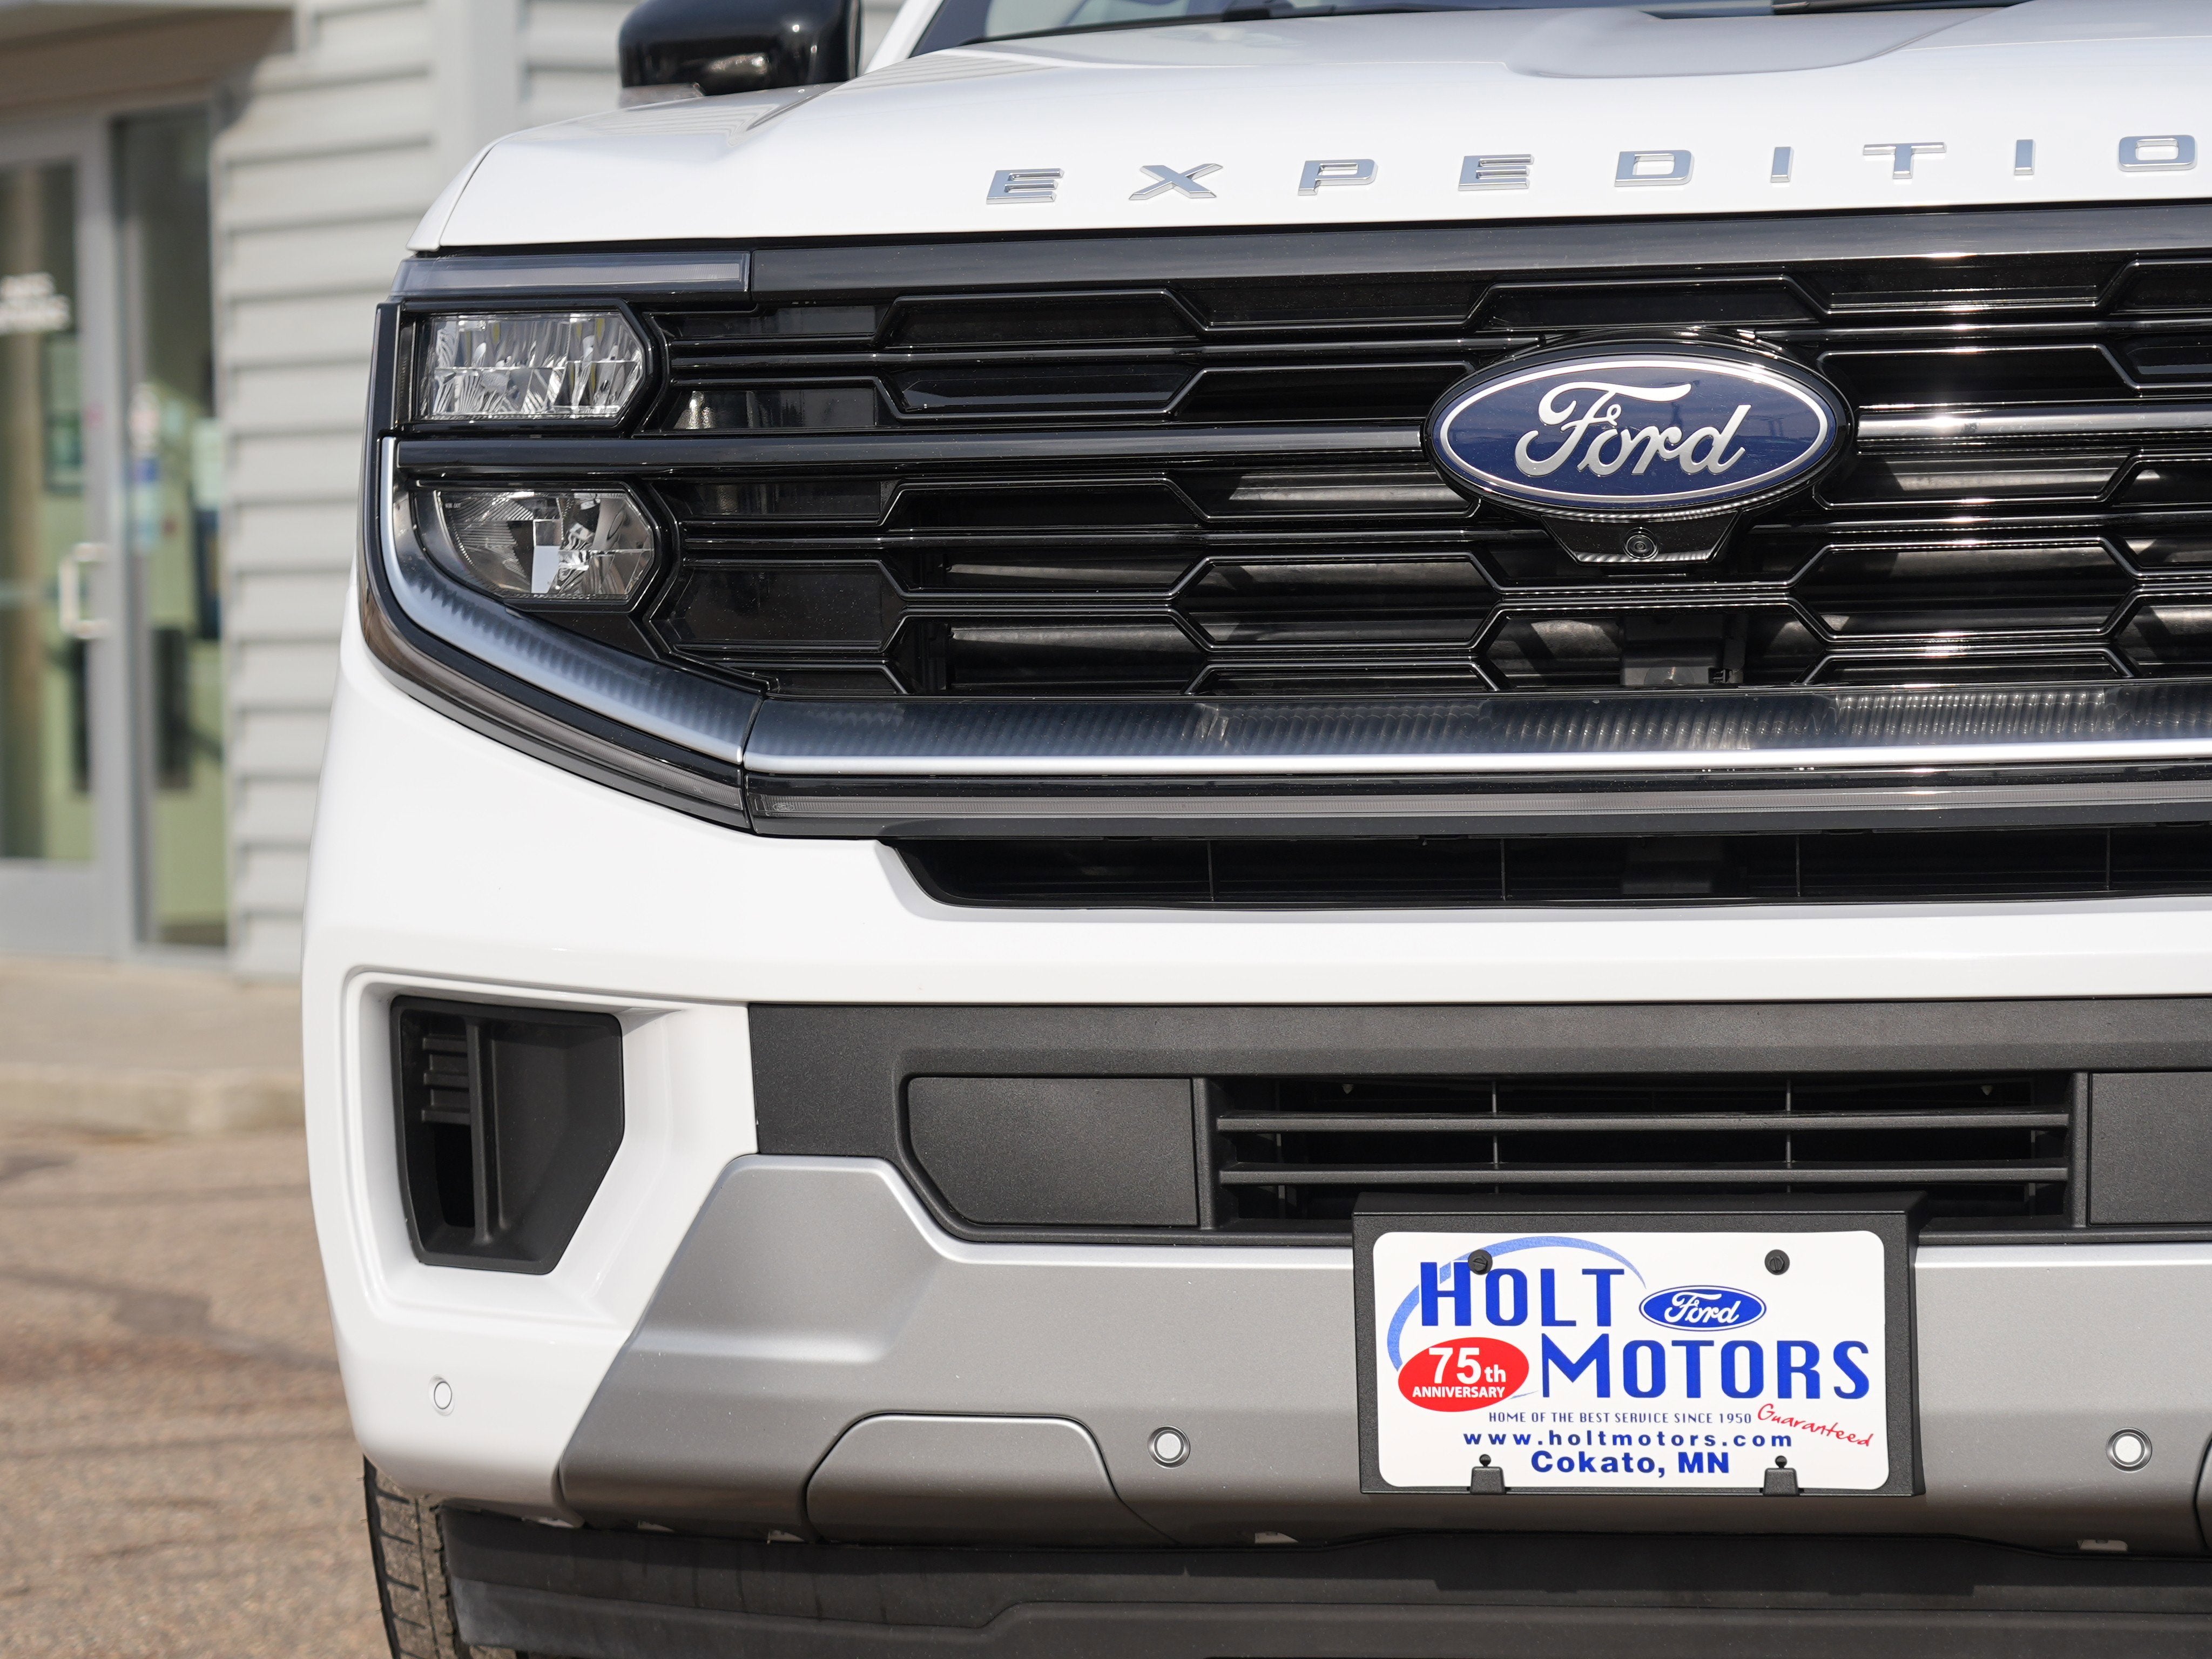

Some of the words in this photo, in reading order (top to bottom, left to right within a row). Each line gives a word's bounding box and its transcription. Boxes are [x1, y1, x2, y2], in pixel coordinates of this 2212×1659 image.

[986, 134, 2197, 204] EXPEDITIO
[1514, 381, 1752, 476] Ford
[1420, 1262, 1624, 1326] HOLT
[1664, 1291, 1742, 1323] Ford
[1428, 1347, 1507, 1385] 75th
[1541, 1333, 1870, 1399] MOTORS
[1412, 1386, 1506, 1398] ANNIVERSARY
[1489, 1412, 1527, 1423] HOME
[1532, 1412, 1547, 1423] OF
[1552, 1412, 1574, 1423] THE
[1580, 1412, 1610, 1424] BEST
[1615, 1413, 1669, 1424] SERVICE
[1674, 1413, 1713, 1424] SINCE
[1719, 1413, 1752, 1424] 1950
[1757, 1403, 1874, 1447] Guaranteed
[1463, 1429, 1792, 1447] www.holtmotors.com
[1531, 1450, 1665, 1478] Cokato,
[1678, 1452, 1729, 1474] MN
